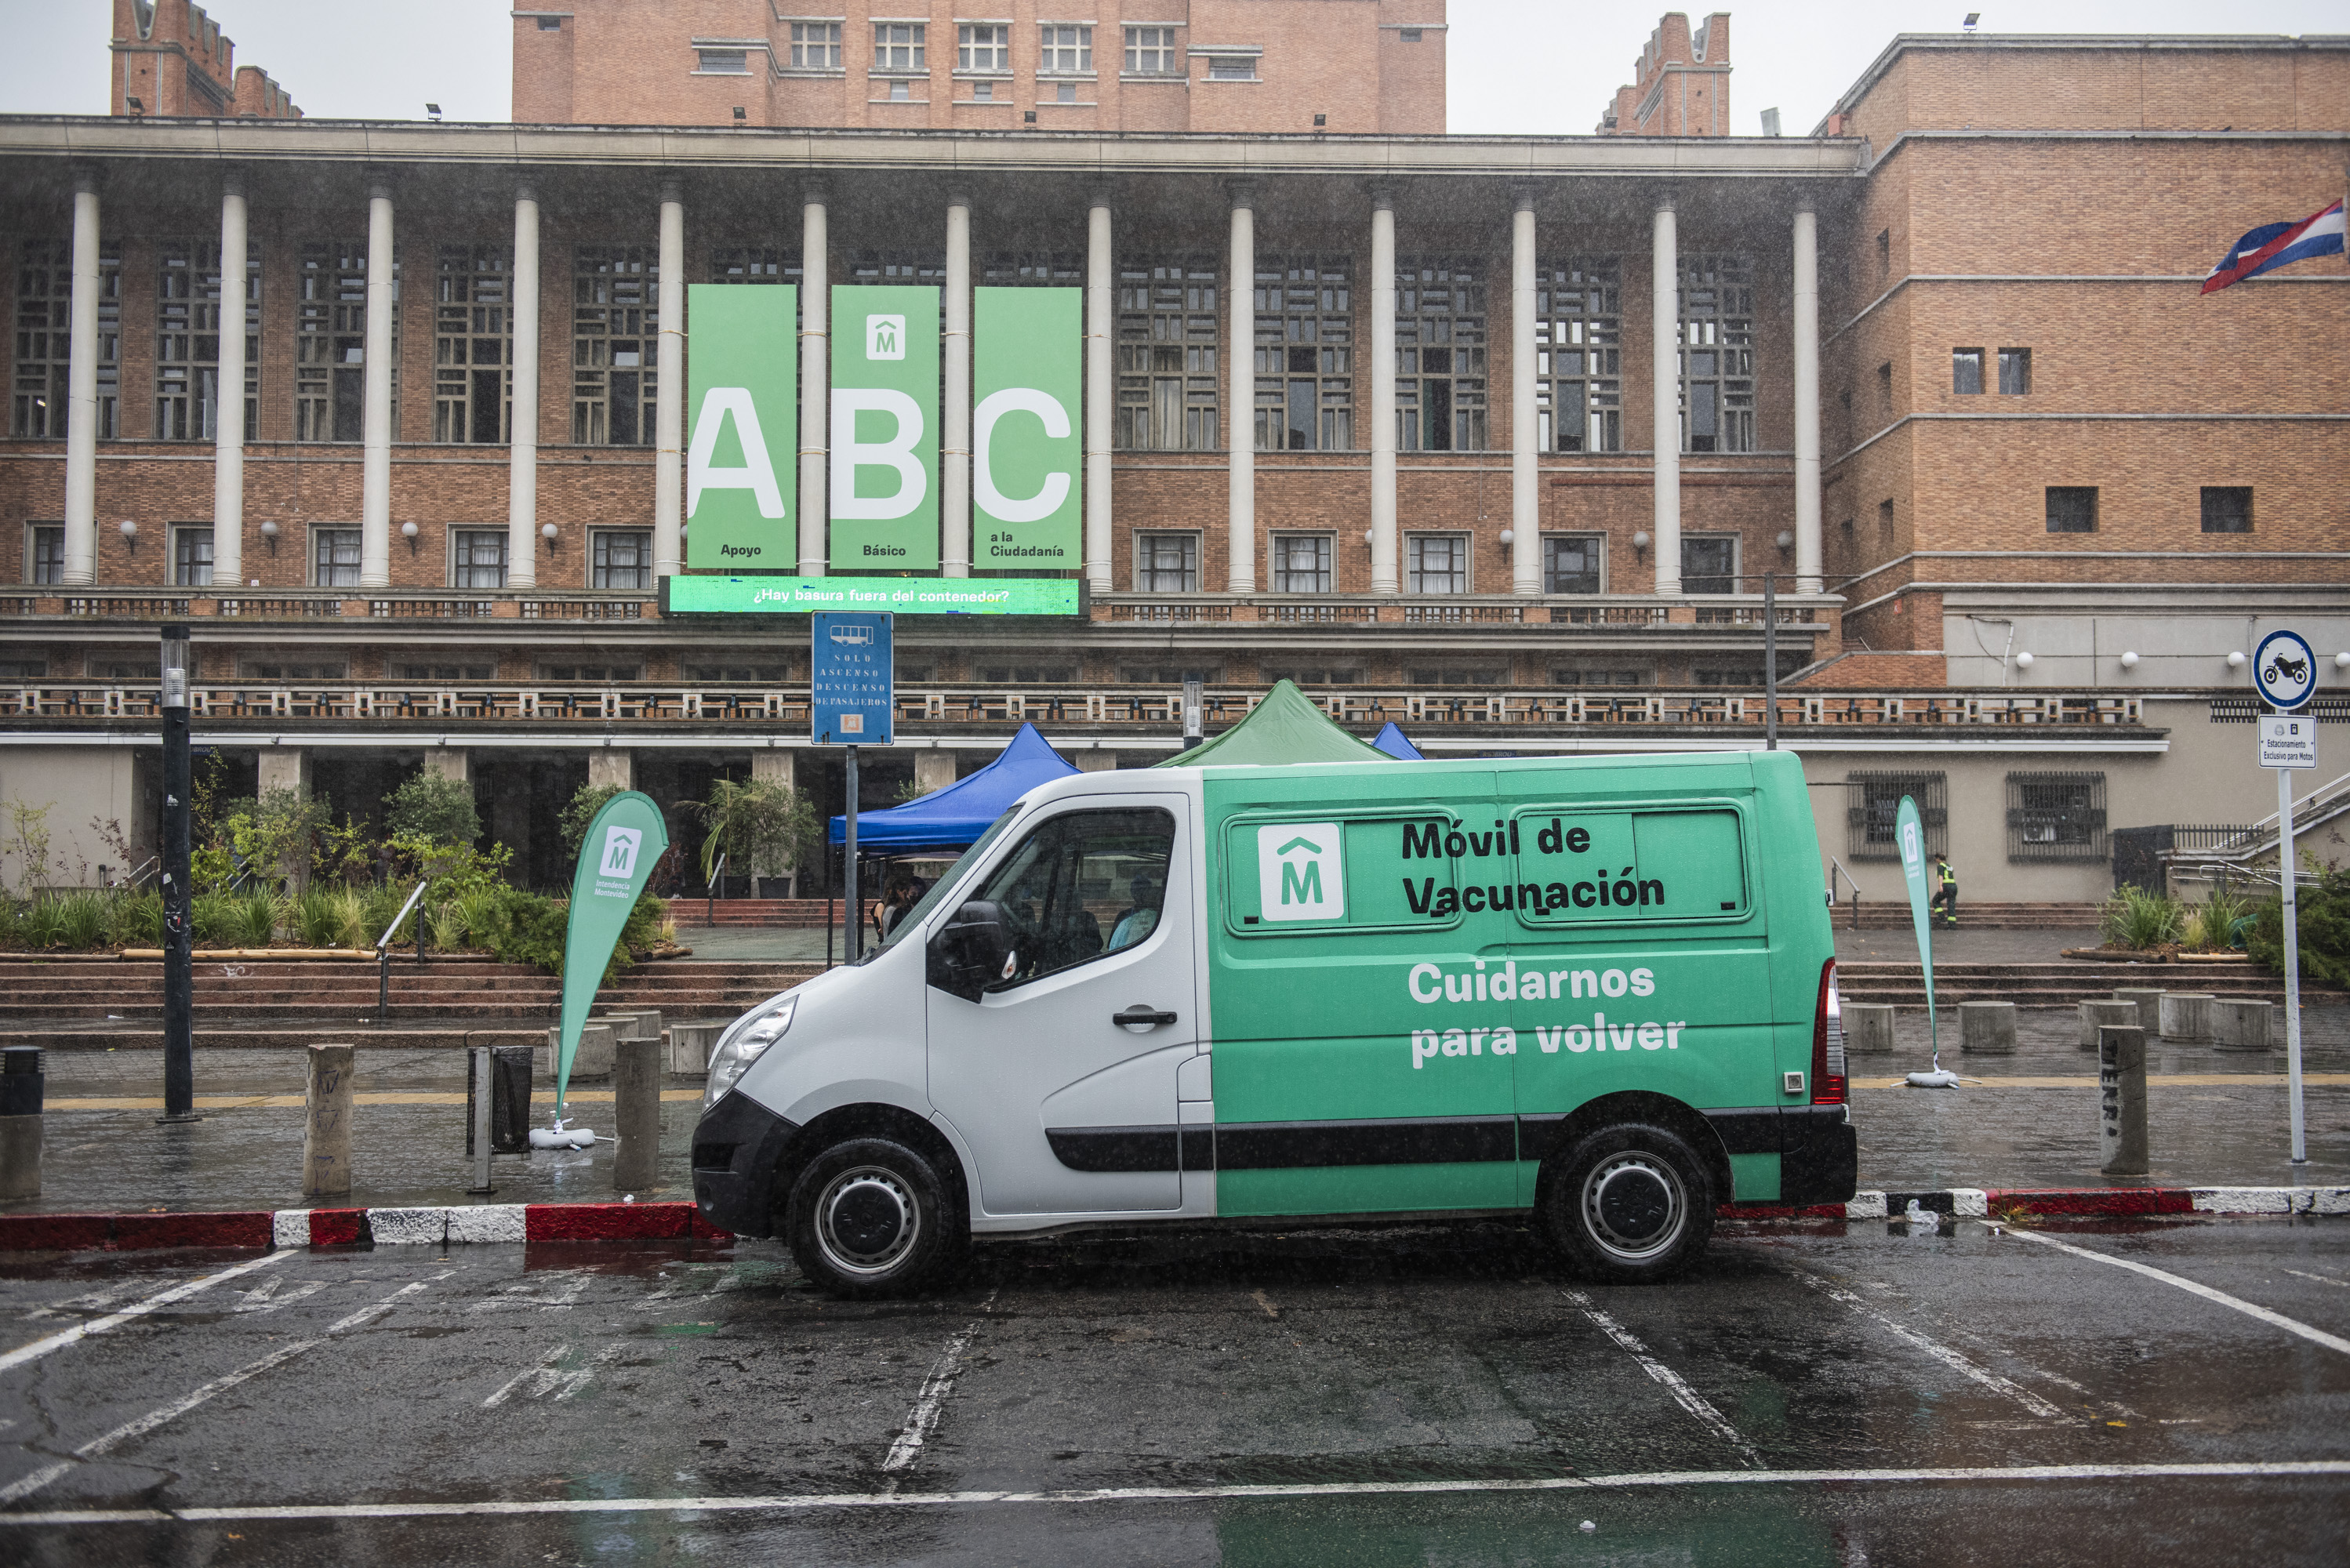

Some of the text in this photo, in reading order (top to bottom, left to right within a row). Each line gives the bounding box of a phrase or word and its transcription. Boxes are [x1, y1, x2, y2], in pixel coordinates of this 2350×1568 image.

[688, 387, 786, 519] A
[830, 388, 927, 520] B
[974, 387, 1071, 523] C
[990, 532, 1013, 543] a la
[721, 544, 761, 557] Apoyo
[863, 545, 906, 557] Básico
[990, 545, 1064, 557] Ciudadanía
[754, 589, 1010, 603] ¿Hay basura fuera del contenedor?
[816, 683, 885, 691] DESCENSO
[830, 698, 887, 706] PASAJEROS
[2268, 739, 2305, 748] Estacionamiento
[2264, 751, 2313, 762] Exclusivo para Motos
[1402, 818, 1590, 859] Móvil de
[596, 880, 630, 889] Intendencia
[1403, 866, 1665, 915] Vacunación
[594, 887, 628, 898] Montevideo
[1409, 960, 1655, 1004] Cuidarnos
[1412, 1012, 1686, 1069] para volver
